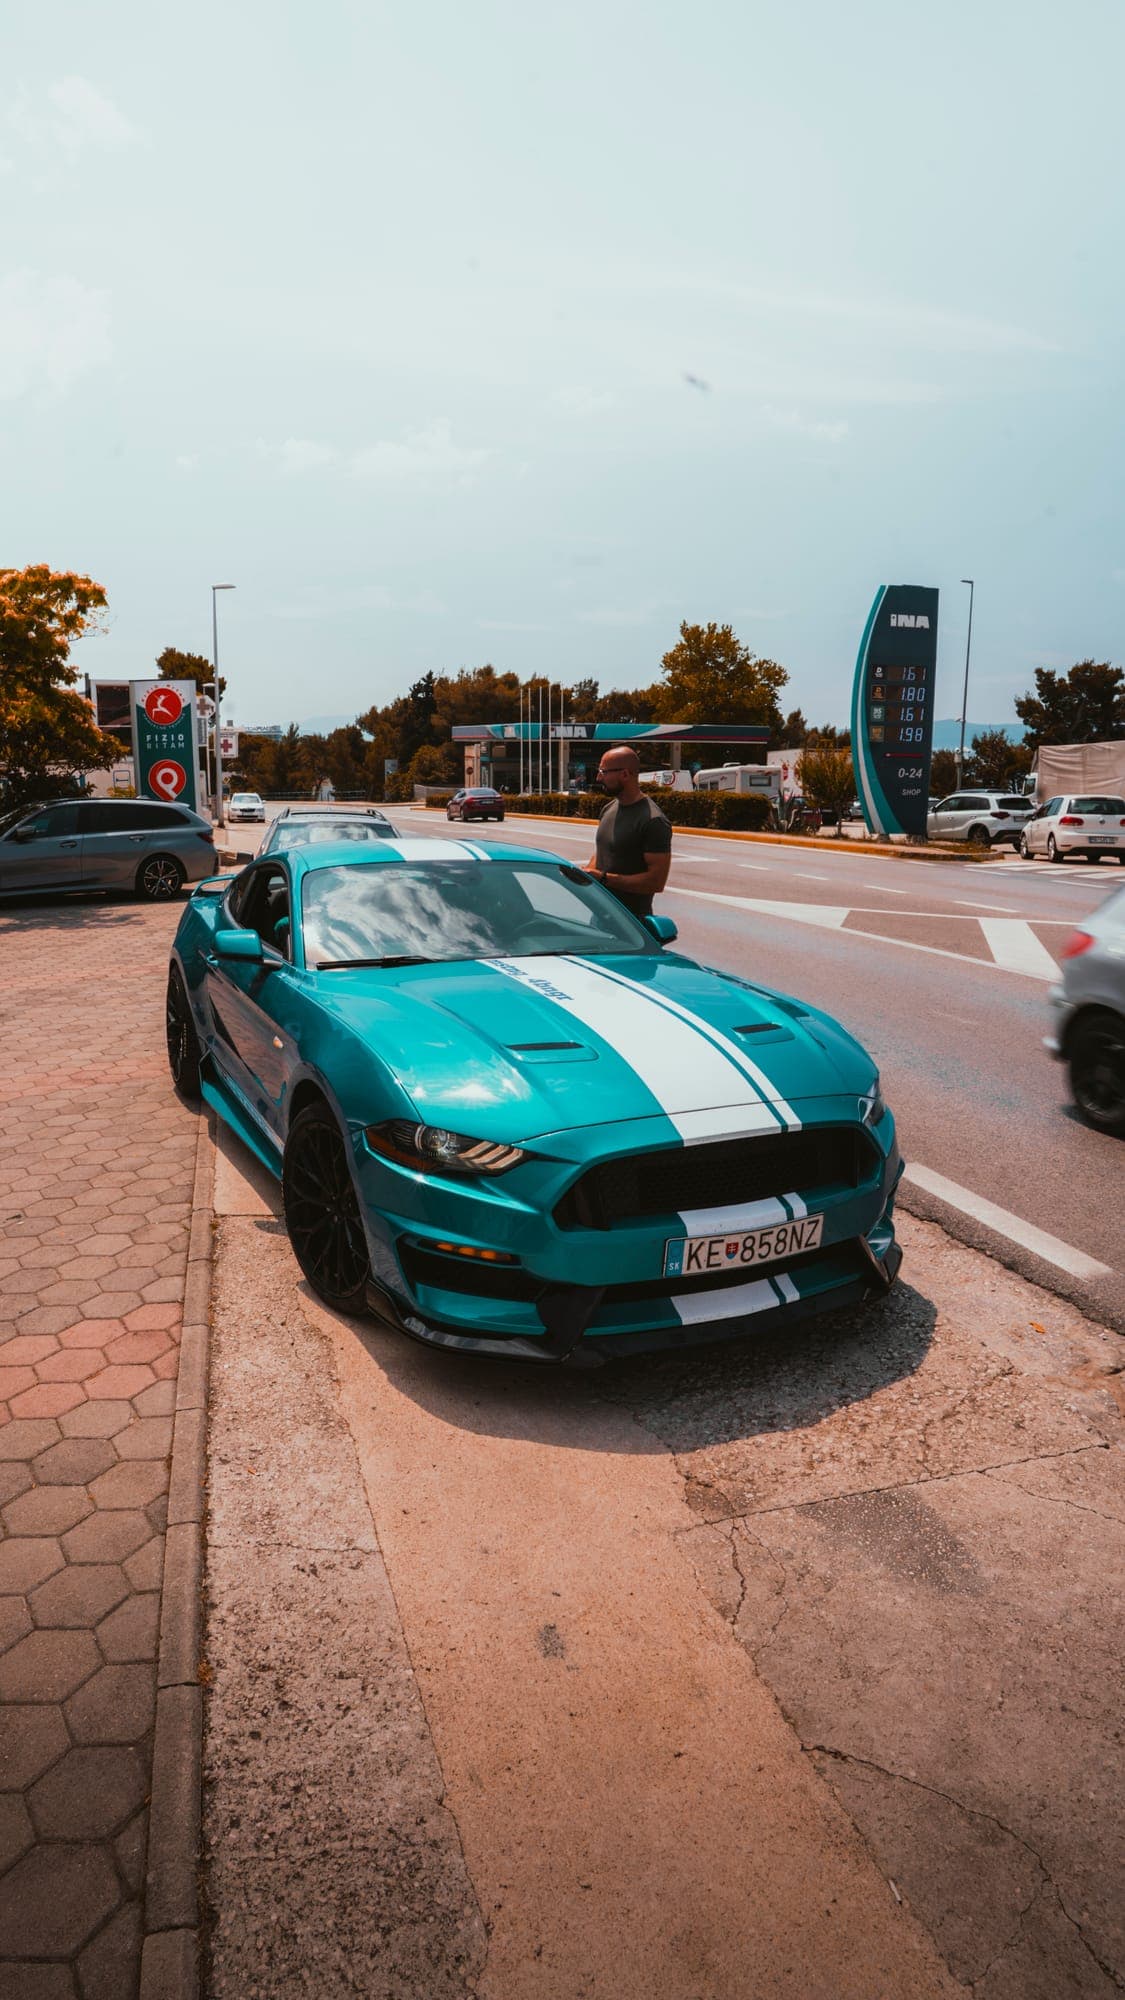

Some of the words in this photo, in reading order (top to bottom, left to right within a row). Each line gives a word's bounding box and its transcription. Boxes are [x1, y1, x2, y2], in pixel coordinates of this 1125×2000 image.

[146, 733, 184, 741] FIZIO
[898, 767, 923, 778] 0-24
[902, 788, 921, 796] SHOP
[686, 1239, 725, 1271] KE
[740, 1219, 820, 1263] 858NZ
[668, 1262, 680, 1271] SK
